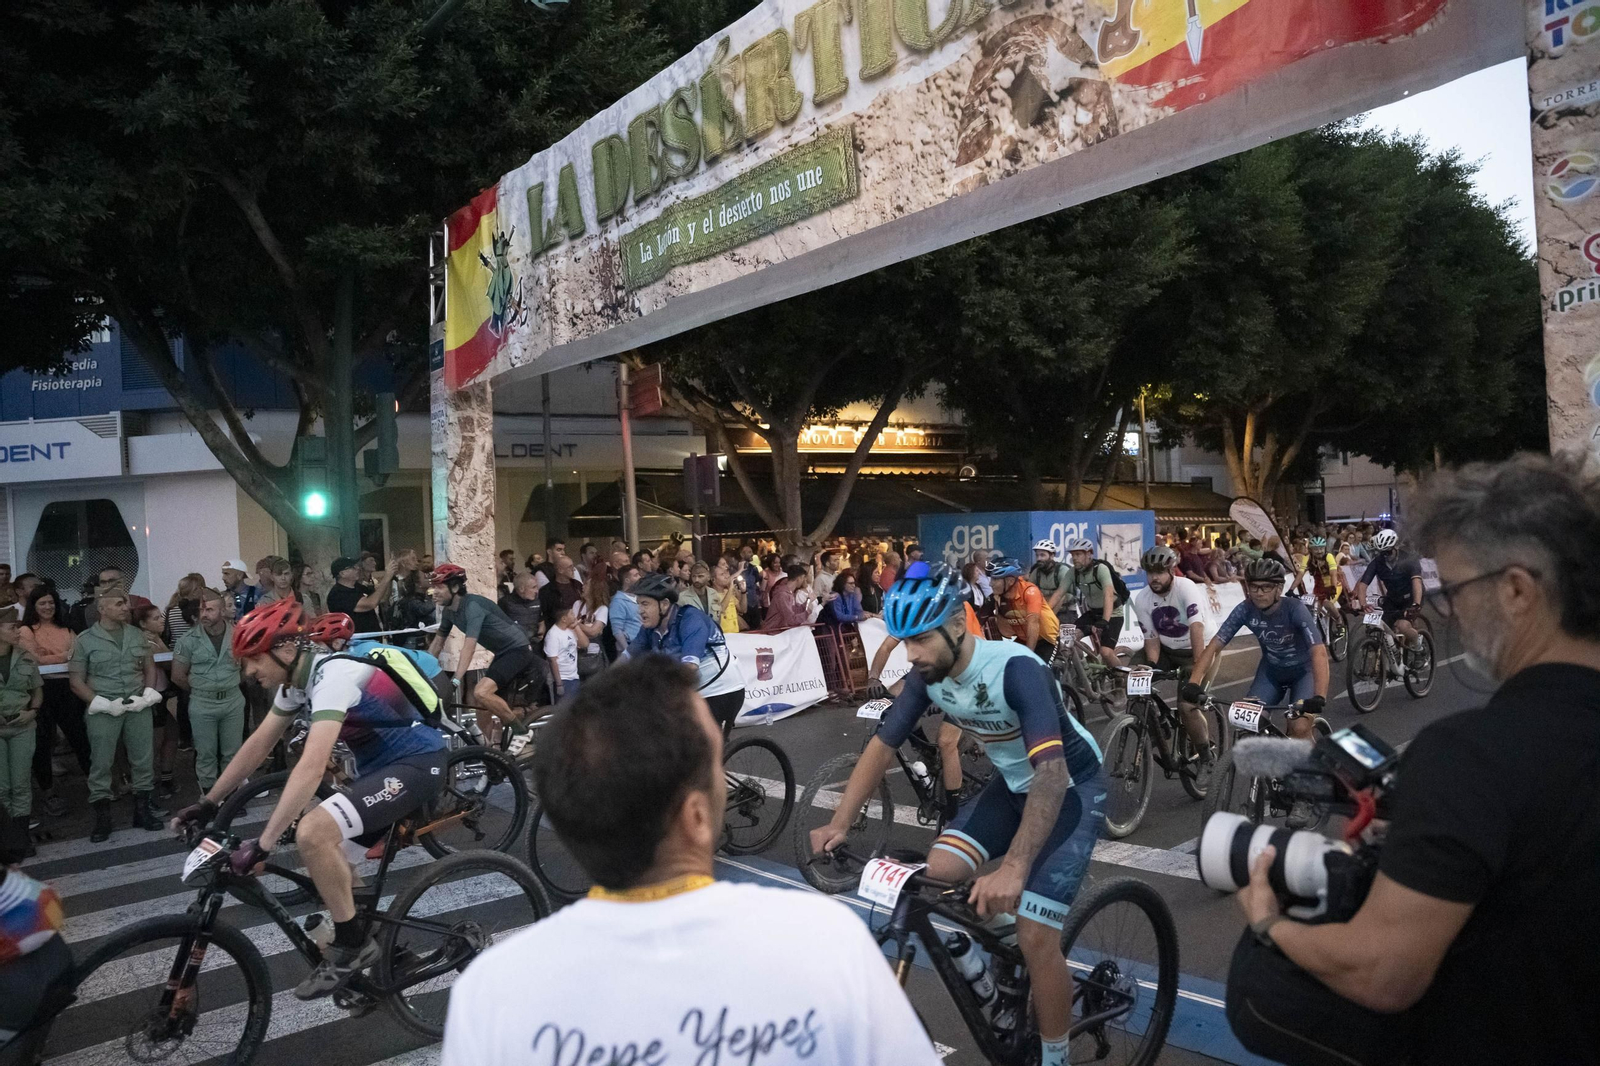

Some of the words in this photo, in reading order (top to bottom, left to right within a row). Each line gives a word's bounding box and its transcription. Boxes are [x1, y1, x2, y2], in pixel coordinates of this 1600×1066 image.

[527, 162, 587, 258] LA
[592, 0, 991, 224] DESÉRTIC
[639, 242, 653, 264] La
[686, 221, 696, 244] y
[703, 209, 714, 235] el
[719, 192, 763, 228] desierto
[769, 179, 792, 206] nos
[796, 165, 823, 192] une
[31, 376, 103, 392] Fisioterapia
[798, 432, 845, 447] MOVIL
[894, 433, 943, 447] ALMERIA
[952, 523, 1000, 560] gar
[1117, 635, 1131, 644] unta
[772, 684, 784, 696] DE
[785, 676, 825, 694] ALMERÍA
[1131, 677, 1150, 688] 7171
[1234, 708, 1259, 724] 5457
[871, 861, 909, 889] 7141
[1025, 901, 1037, 914] LA
[679, 1005, 822, 1066] Yepes
